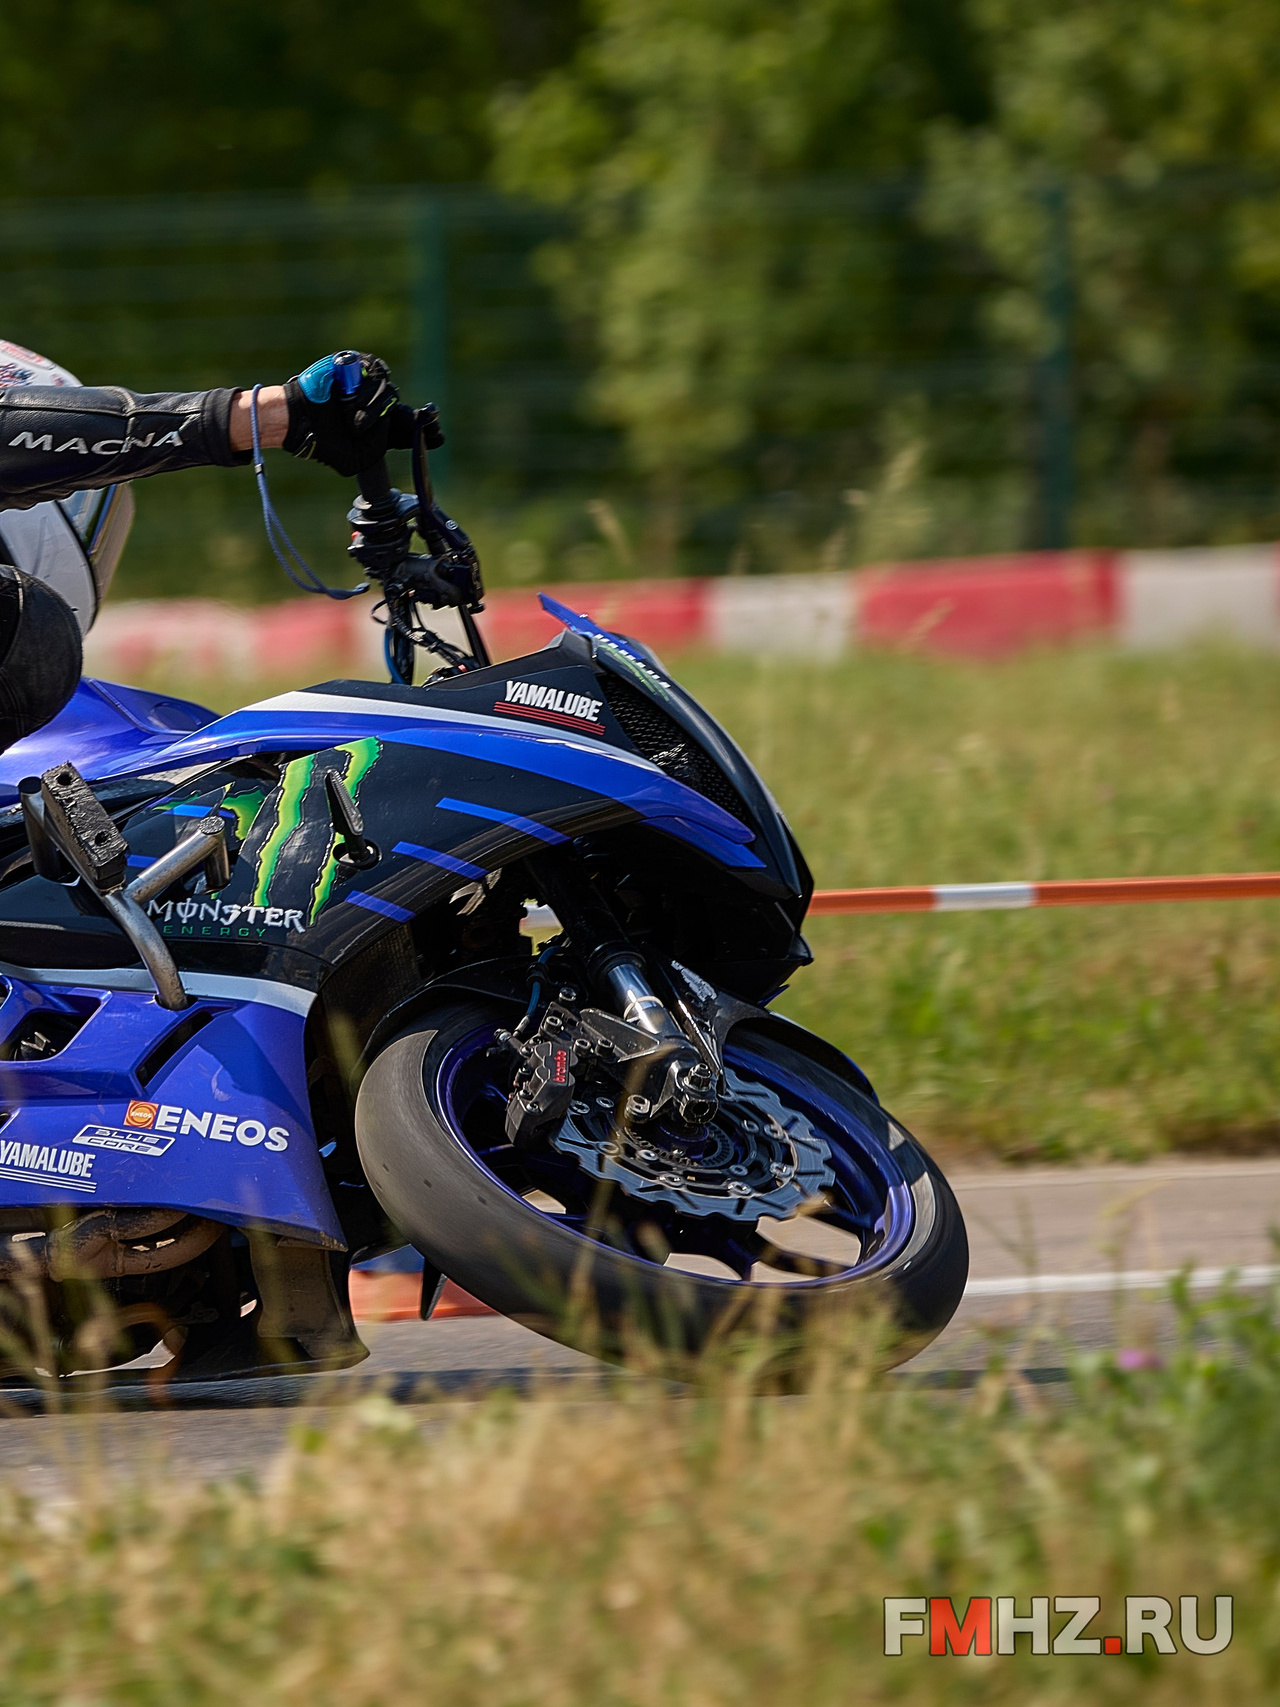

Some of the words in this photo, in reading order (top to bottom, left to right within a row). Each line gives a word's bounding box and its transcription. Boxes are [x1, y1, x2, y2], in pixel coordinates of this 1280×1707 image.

[8, 431, 183, 455] MACNA
[505, 680, 603, 722] YAMALUBE
[147, 898, 306, 934] MONSTER
[163, 925, 266, 938] ENERGY
[94, 1128, 160, 1145] BLUE
[154, 1105, 290, 1152] ENEOS
[87, 1137, 152, 1153] CORE
